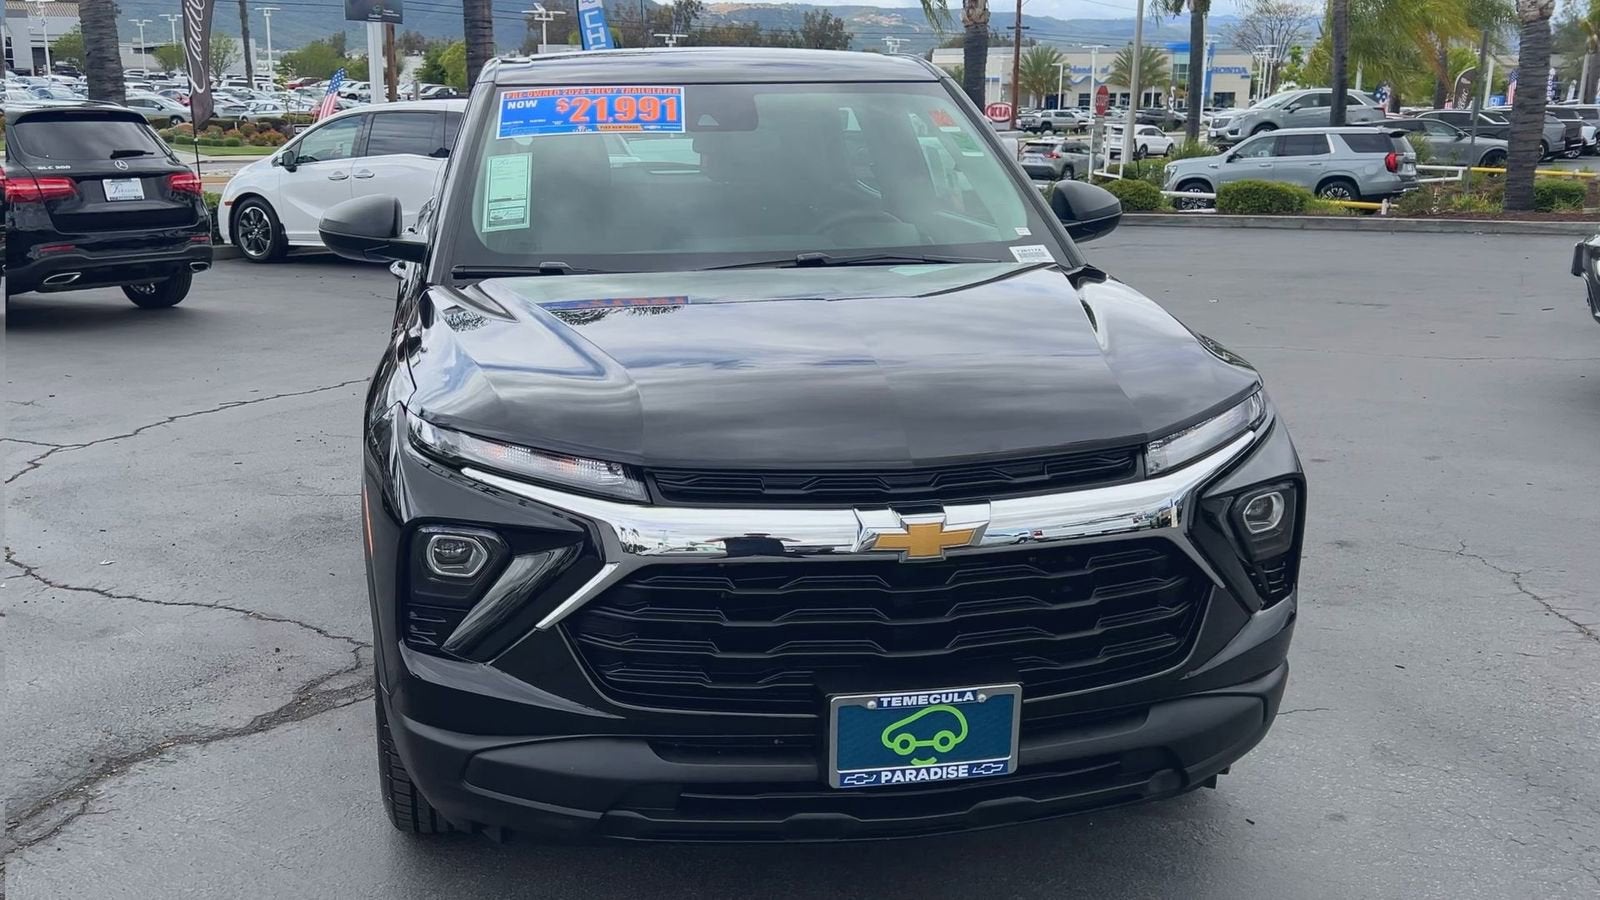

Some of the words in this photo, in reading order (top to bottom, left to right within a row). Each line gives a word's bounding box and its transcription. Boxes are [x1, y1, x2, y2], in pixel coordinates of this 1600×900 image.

[1211, 66, 1248, 75] HONDA
[507, 99, 538, 110] NOW
[988, 106, 1009, 117] KIA
[880, 692, 974, 707] TEMECULA
[881, 765, 969, 784] PARADISE
